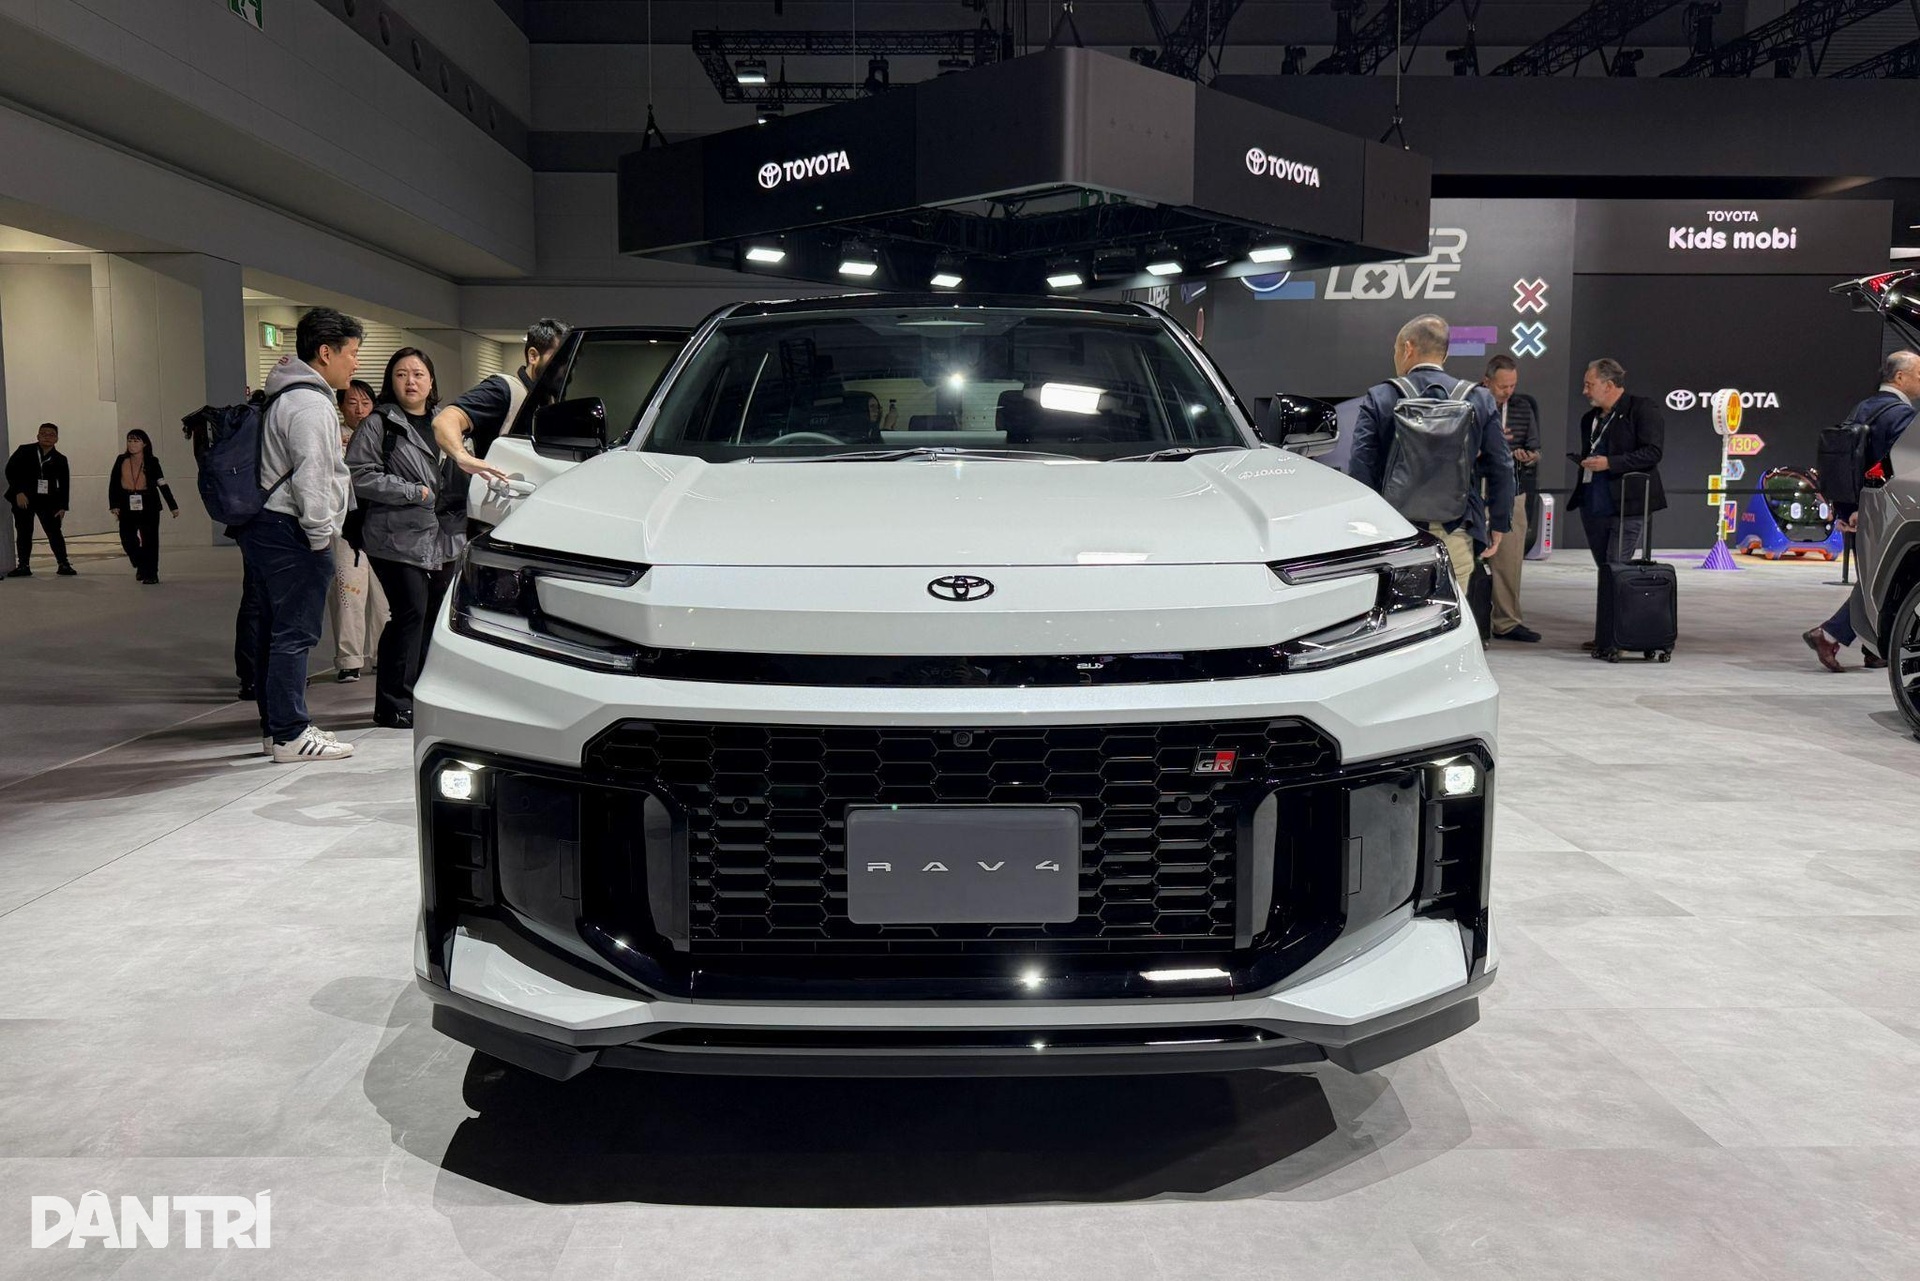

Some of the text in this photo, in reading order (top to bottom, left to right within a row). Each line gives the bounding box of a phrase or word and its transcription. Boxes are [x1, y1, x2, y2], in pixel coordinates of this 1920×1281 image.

[783, 150, 850, 182] TOYOTA
[1268, 155, 1320, 188] TOYOTA
[1707, 211, 1758, 221] TOYOTA
[1669, 227, 1797, 249] Kids mobi
[1324, 264, 1461, 299] LOVE
[1698, 392, 1779, 408] TOTA
[1197, 759, 1233, 771] GR
[867, 860, 1060, 872] RAV4
